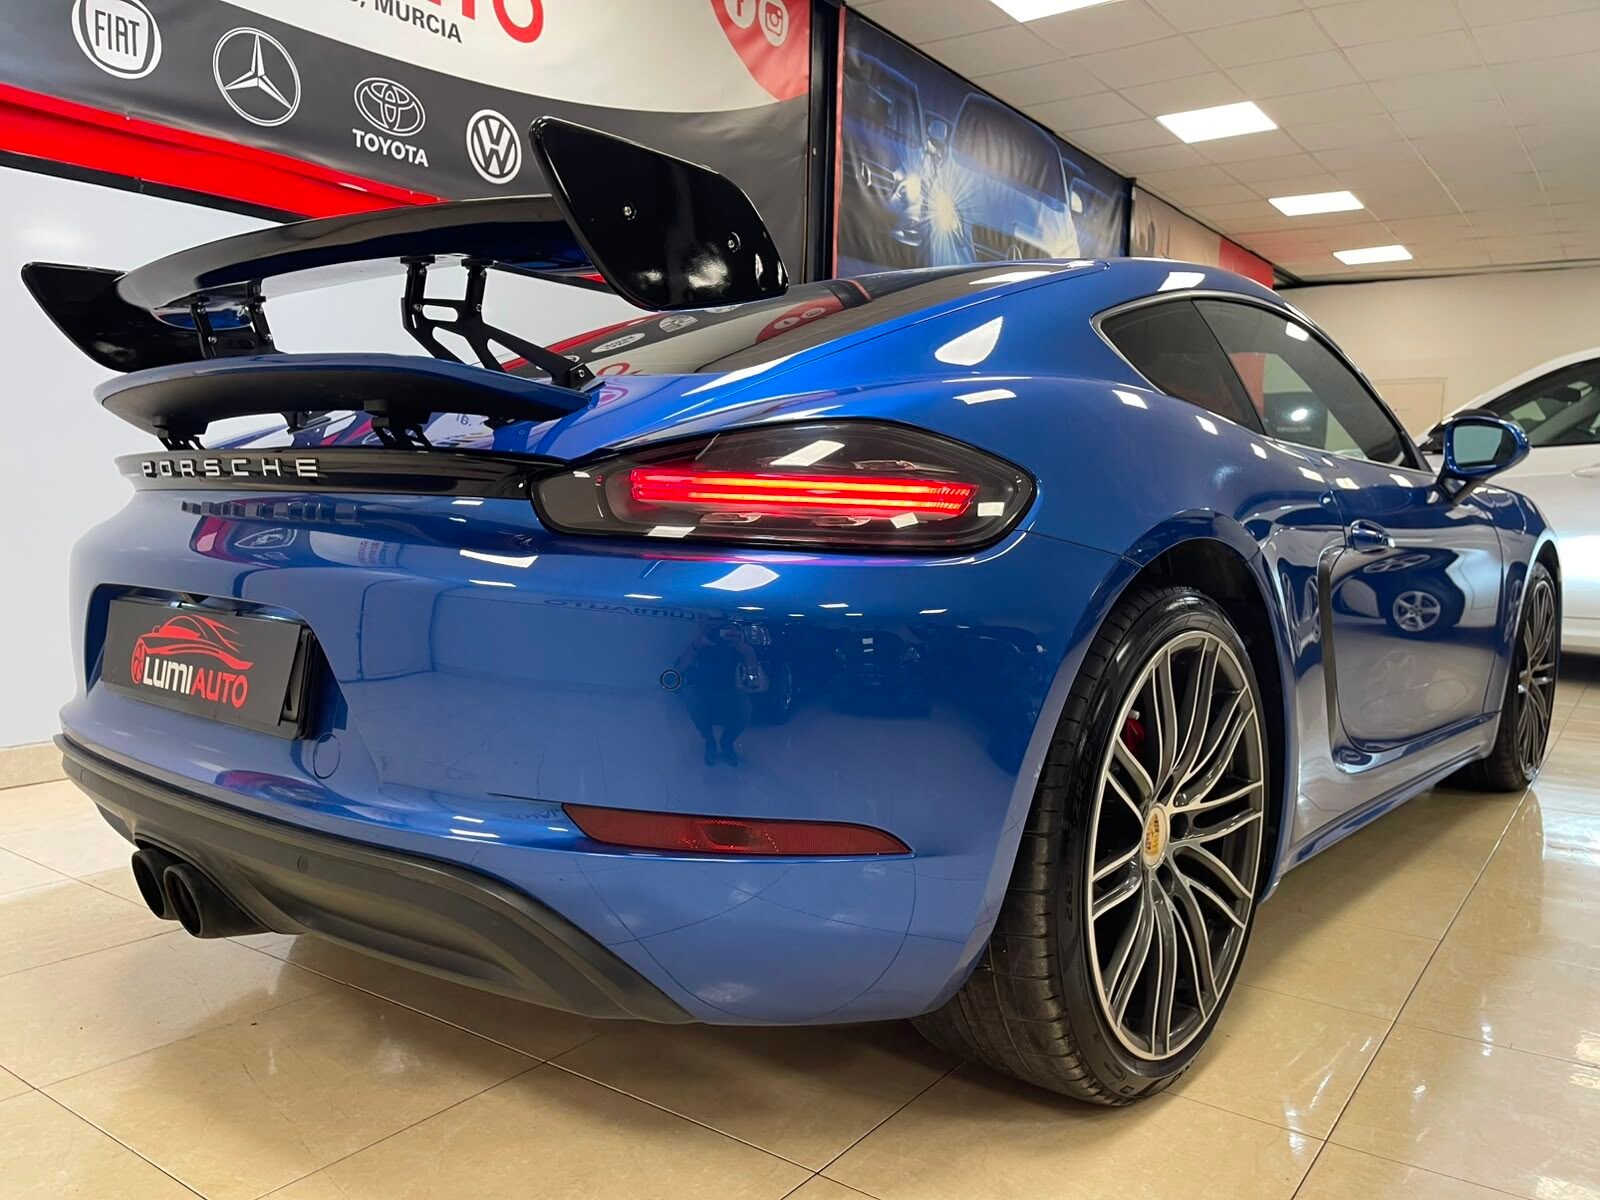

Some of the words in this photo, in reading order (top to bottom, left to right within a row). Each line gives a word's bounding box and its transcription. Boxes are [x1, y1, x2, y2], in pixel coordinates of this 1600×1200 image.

[95, 9, 140, 57] FIAT
[374, 0, 462, 44] MURCIA
[352, 128, 429, 167] TOYOTA
[141, 457, 319, 478] PORSCHE
